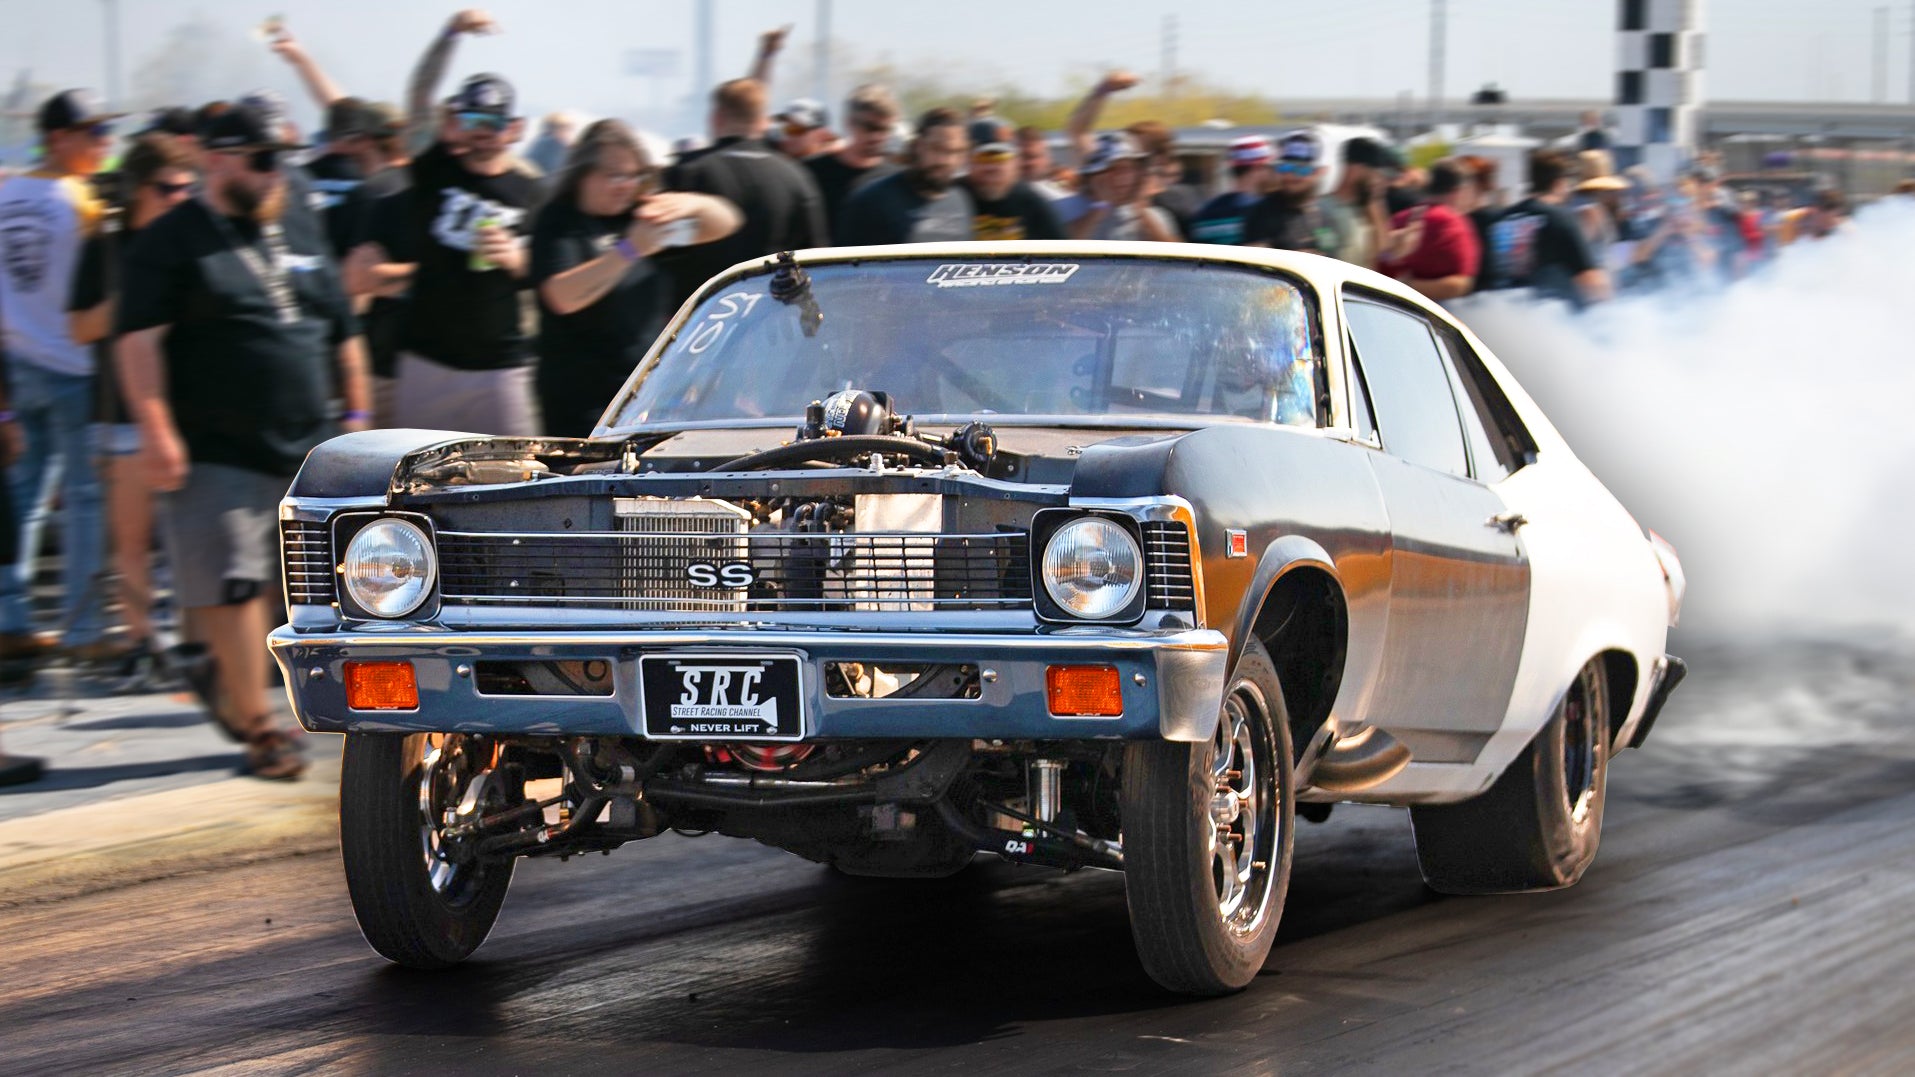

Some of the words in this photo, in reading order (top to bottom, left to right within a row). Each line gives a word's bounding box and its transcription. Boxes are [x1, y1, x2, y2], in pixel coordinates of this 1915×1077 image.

[928, 264, 1079, 282] HENSON
[688, 563, 753, 587] SS
[680, 669, 762, 706] SRC
[672, 706, 699, 716] STREET
[700, 706, 727, 717] RACING
[728, 707, 762, 717] CHANNEL
[691, 723, 731, 732] NEVER
[734, 724, 759, 732] LIFT
